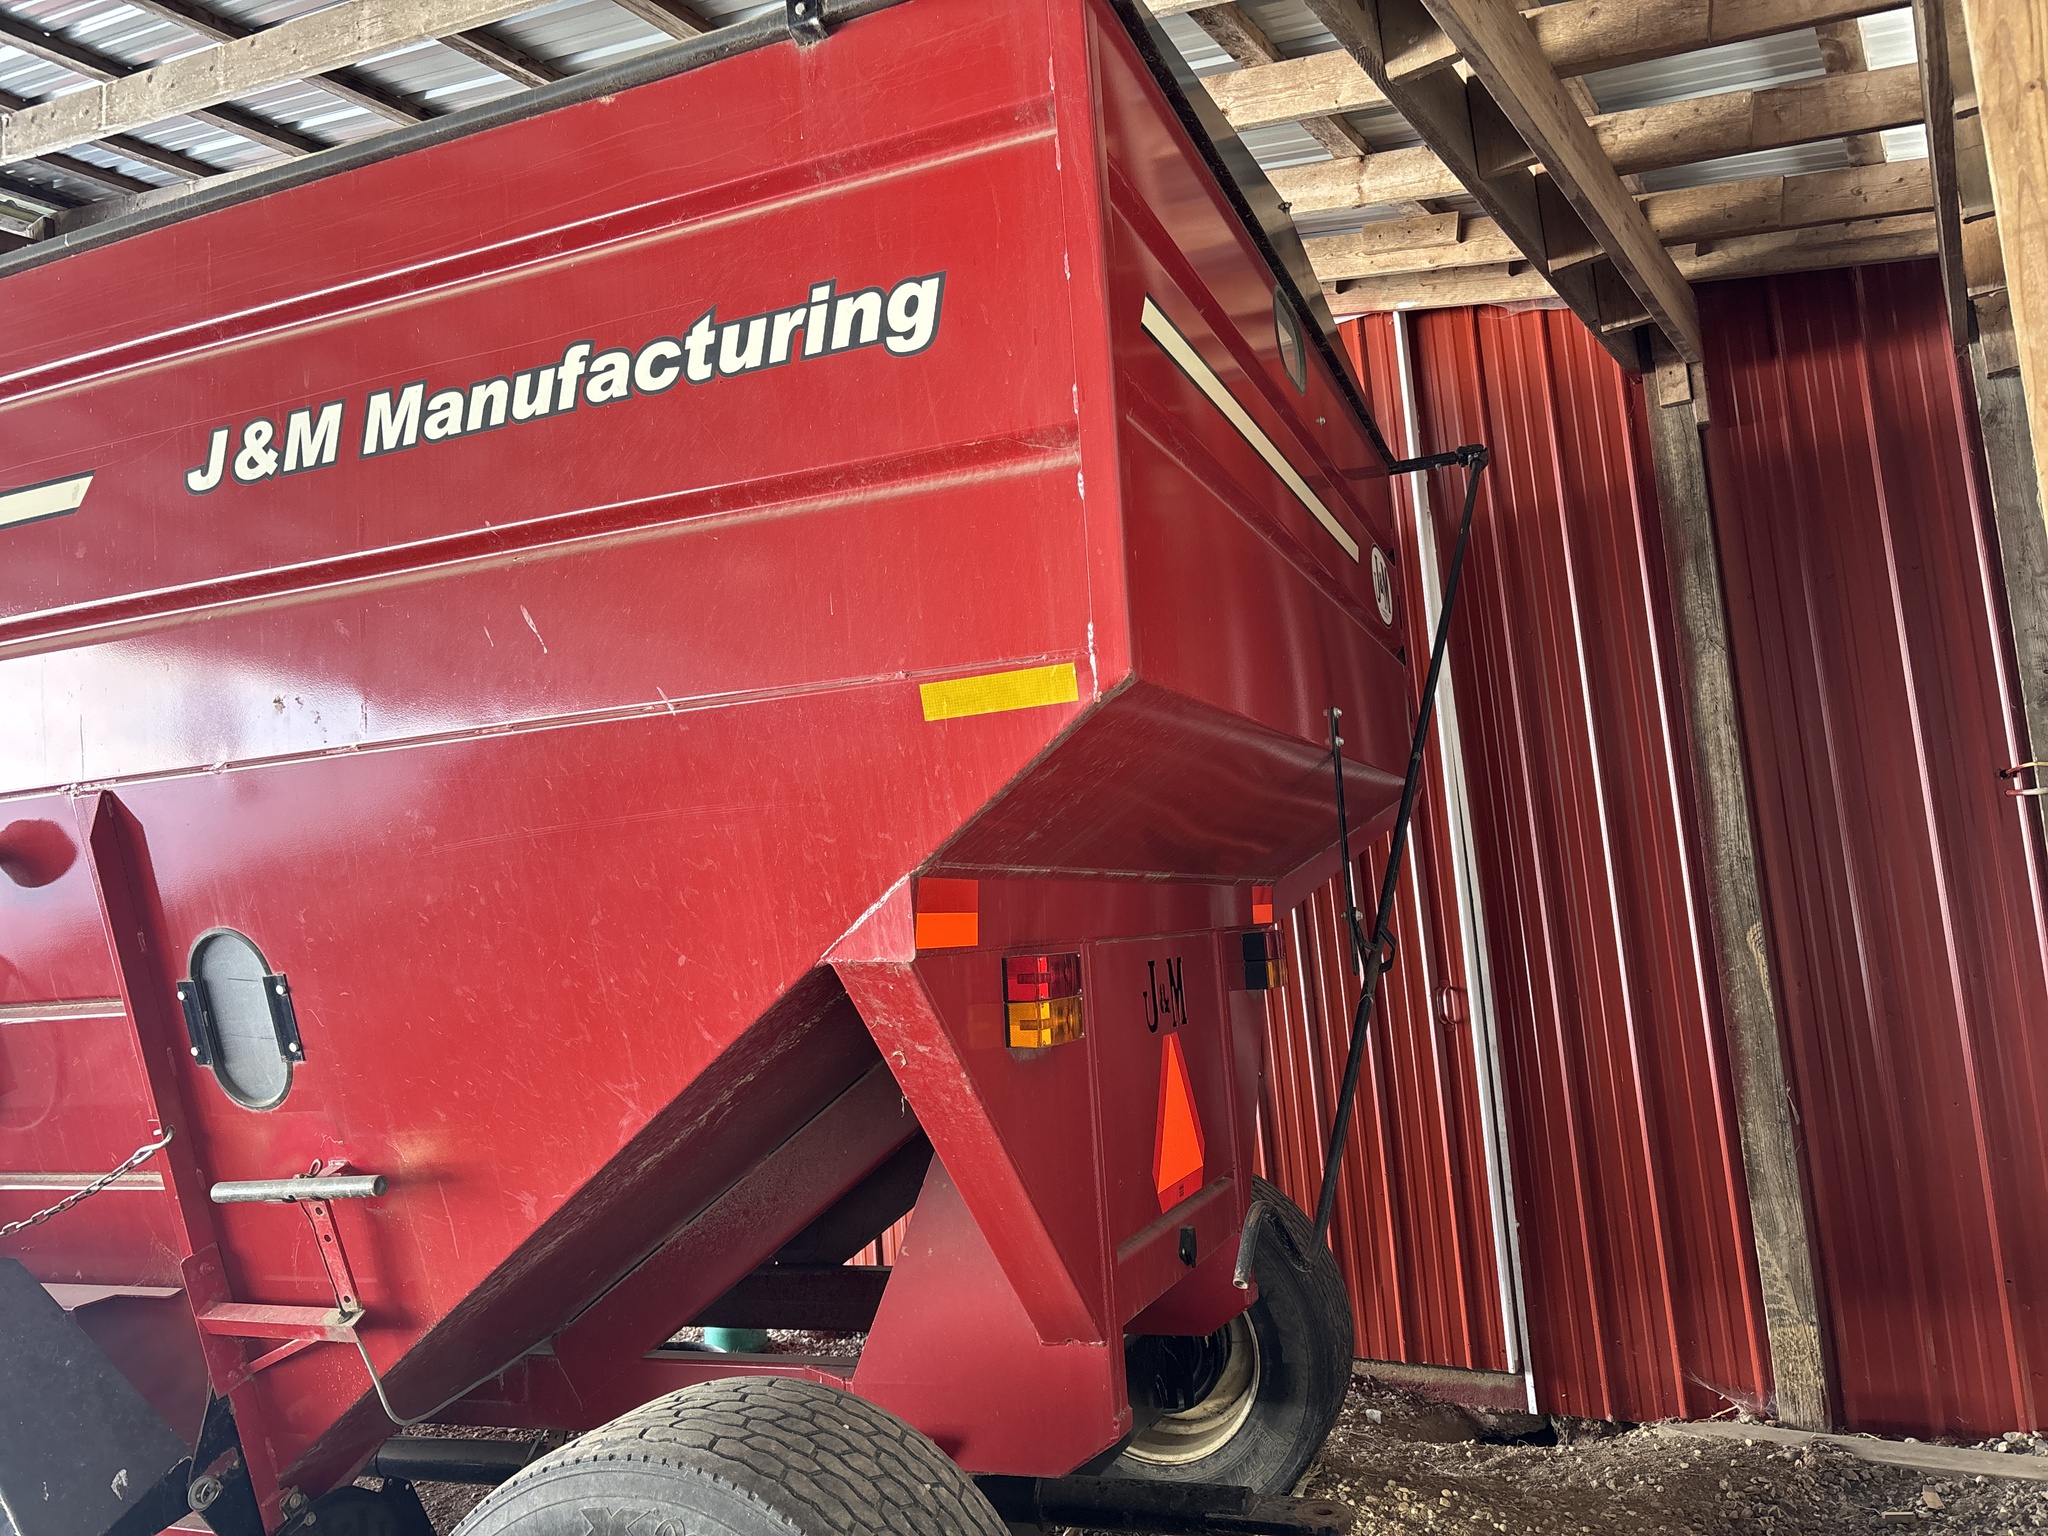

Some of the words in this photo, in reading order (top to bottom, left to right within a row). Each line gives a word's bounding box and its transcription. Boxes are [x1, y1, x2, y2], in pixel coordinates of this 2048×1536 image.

[185, 399, 346, 494] J&M
[359, 272, 945, 459] Manufacturing
[1142, 956, 1188, 1033] J&M
